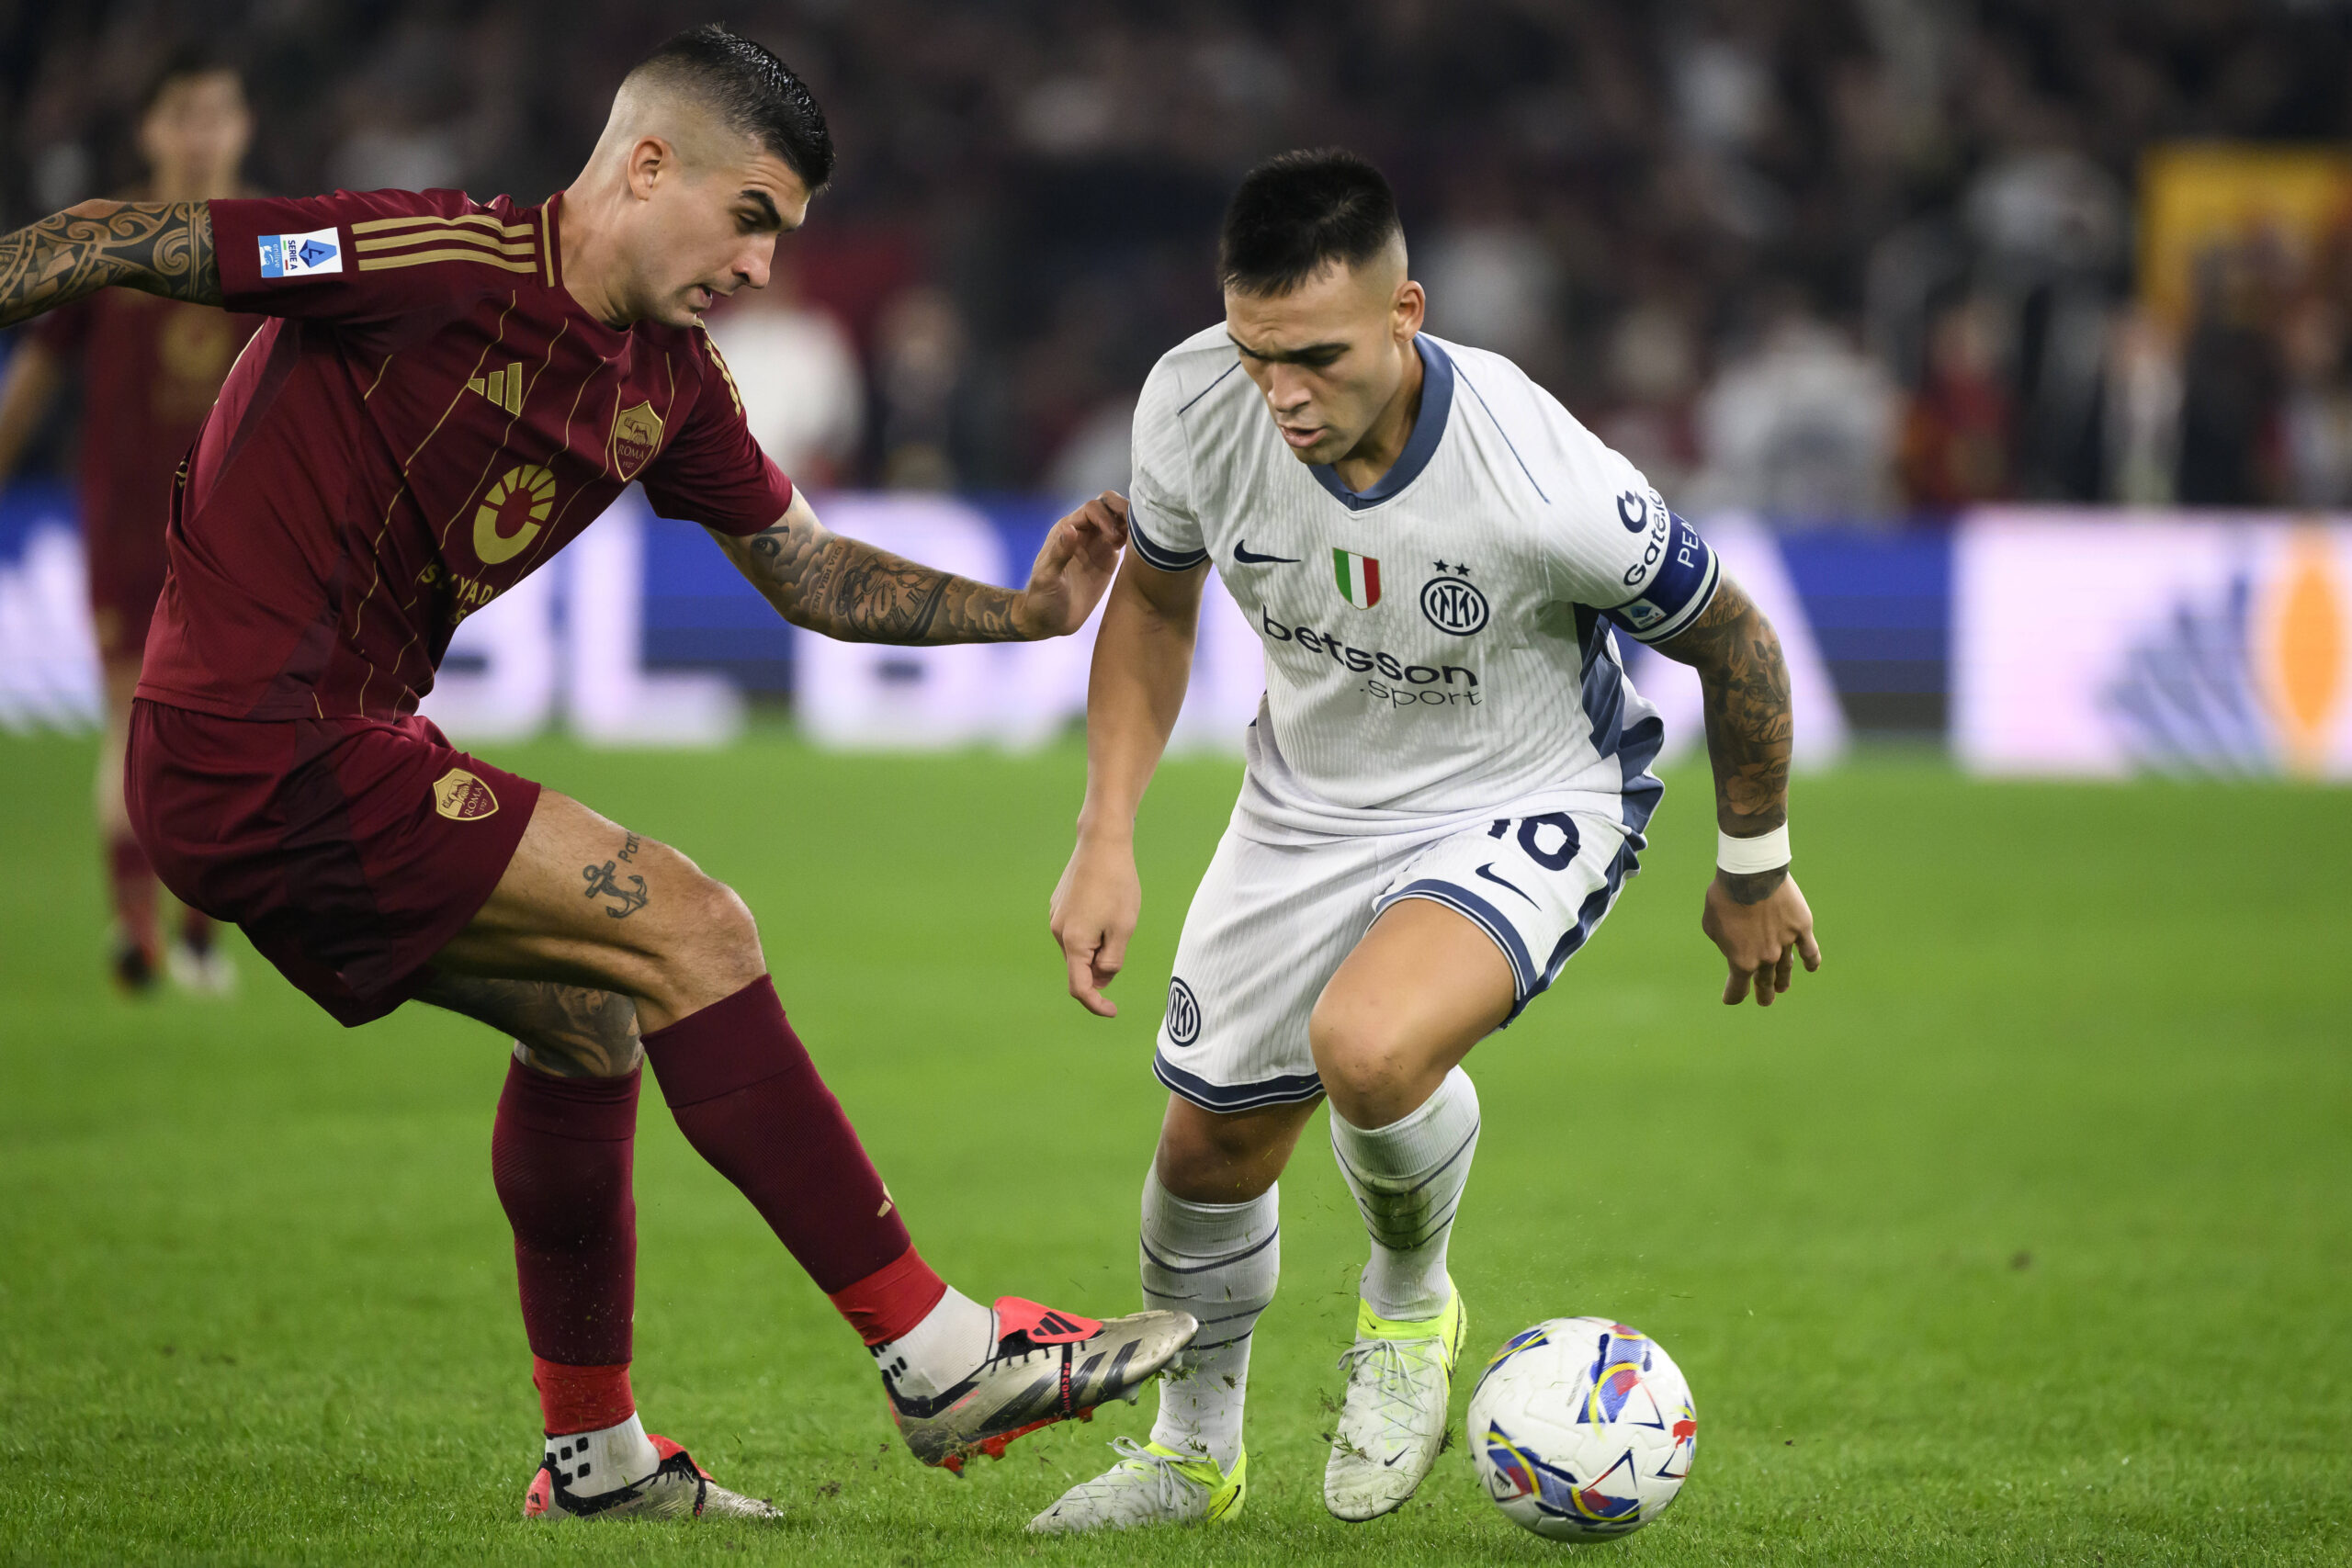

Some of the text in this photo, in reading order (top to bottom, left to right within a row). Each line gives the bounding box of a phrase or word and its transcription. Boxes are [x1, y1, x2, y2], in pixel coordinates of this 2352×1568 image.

[272, 243, 280, 268] enilive
[288, 240, 298, 263] SERIE
[617, 444, 644, 460] ROMA
[1677, 513, 1699, 569] PEA
[1262, 603, 1478, 687] betsson
[464, 787, 483, 817] ROMA
